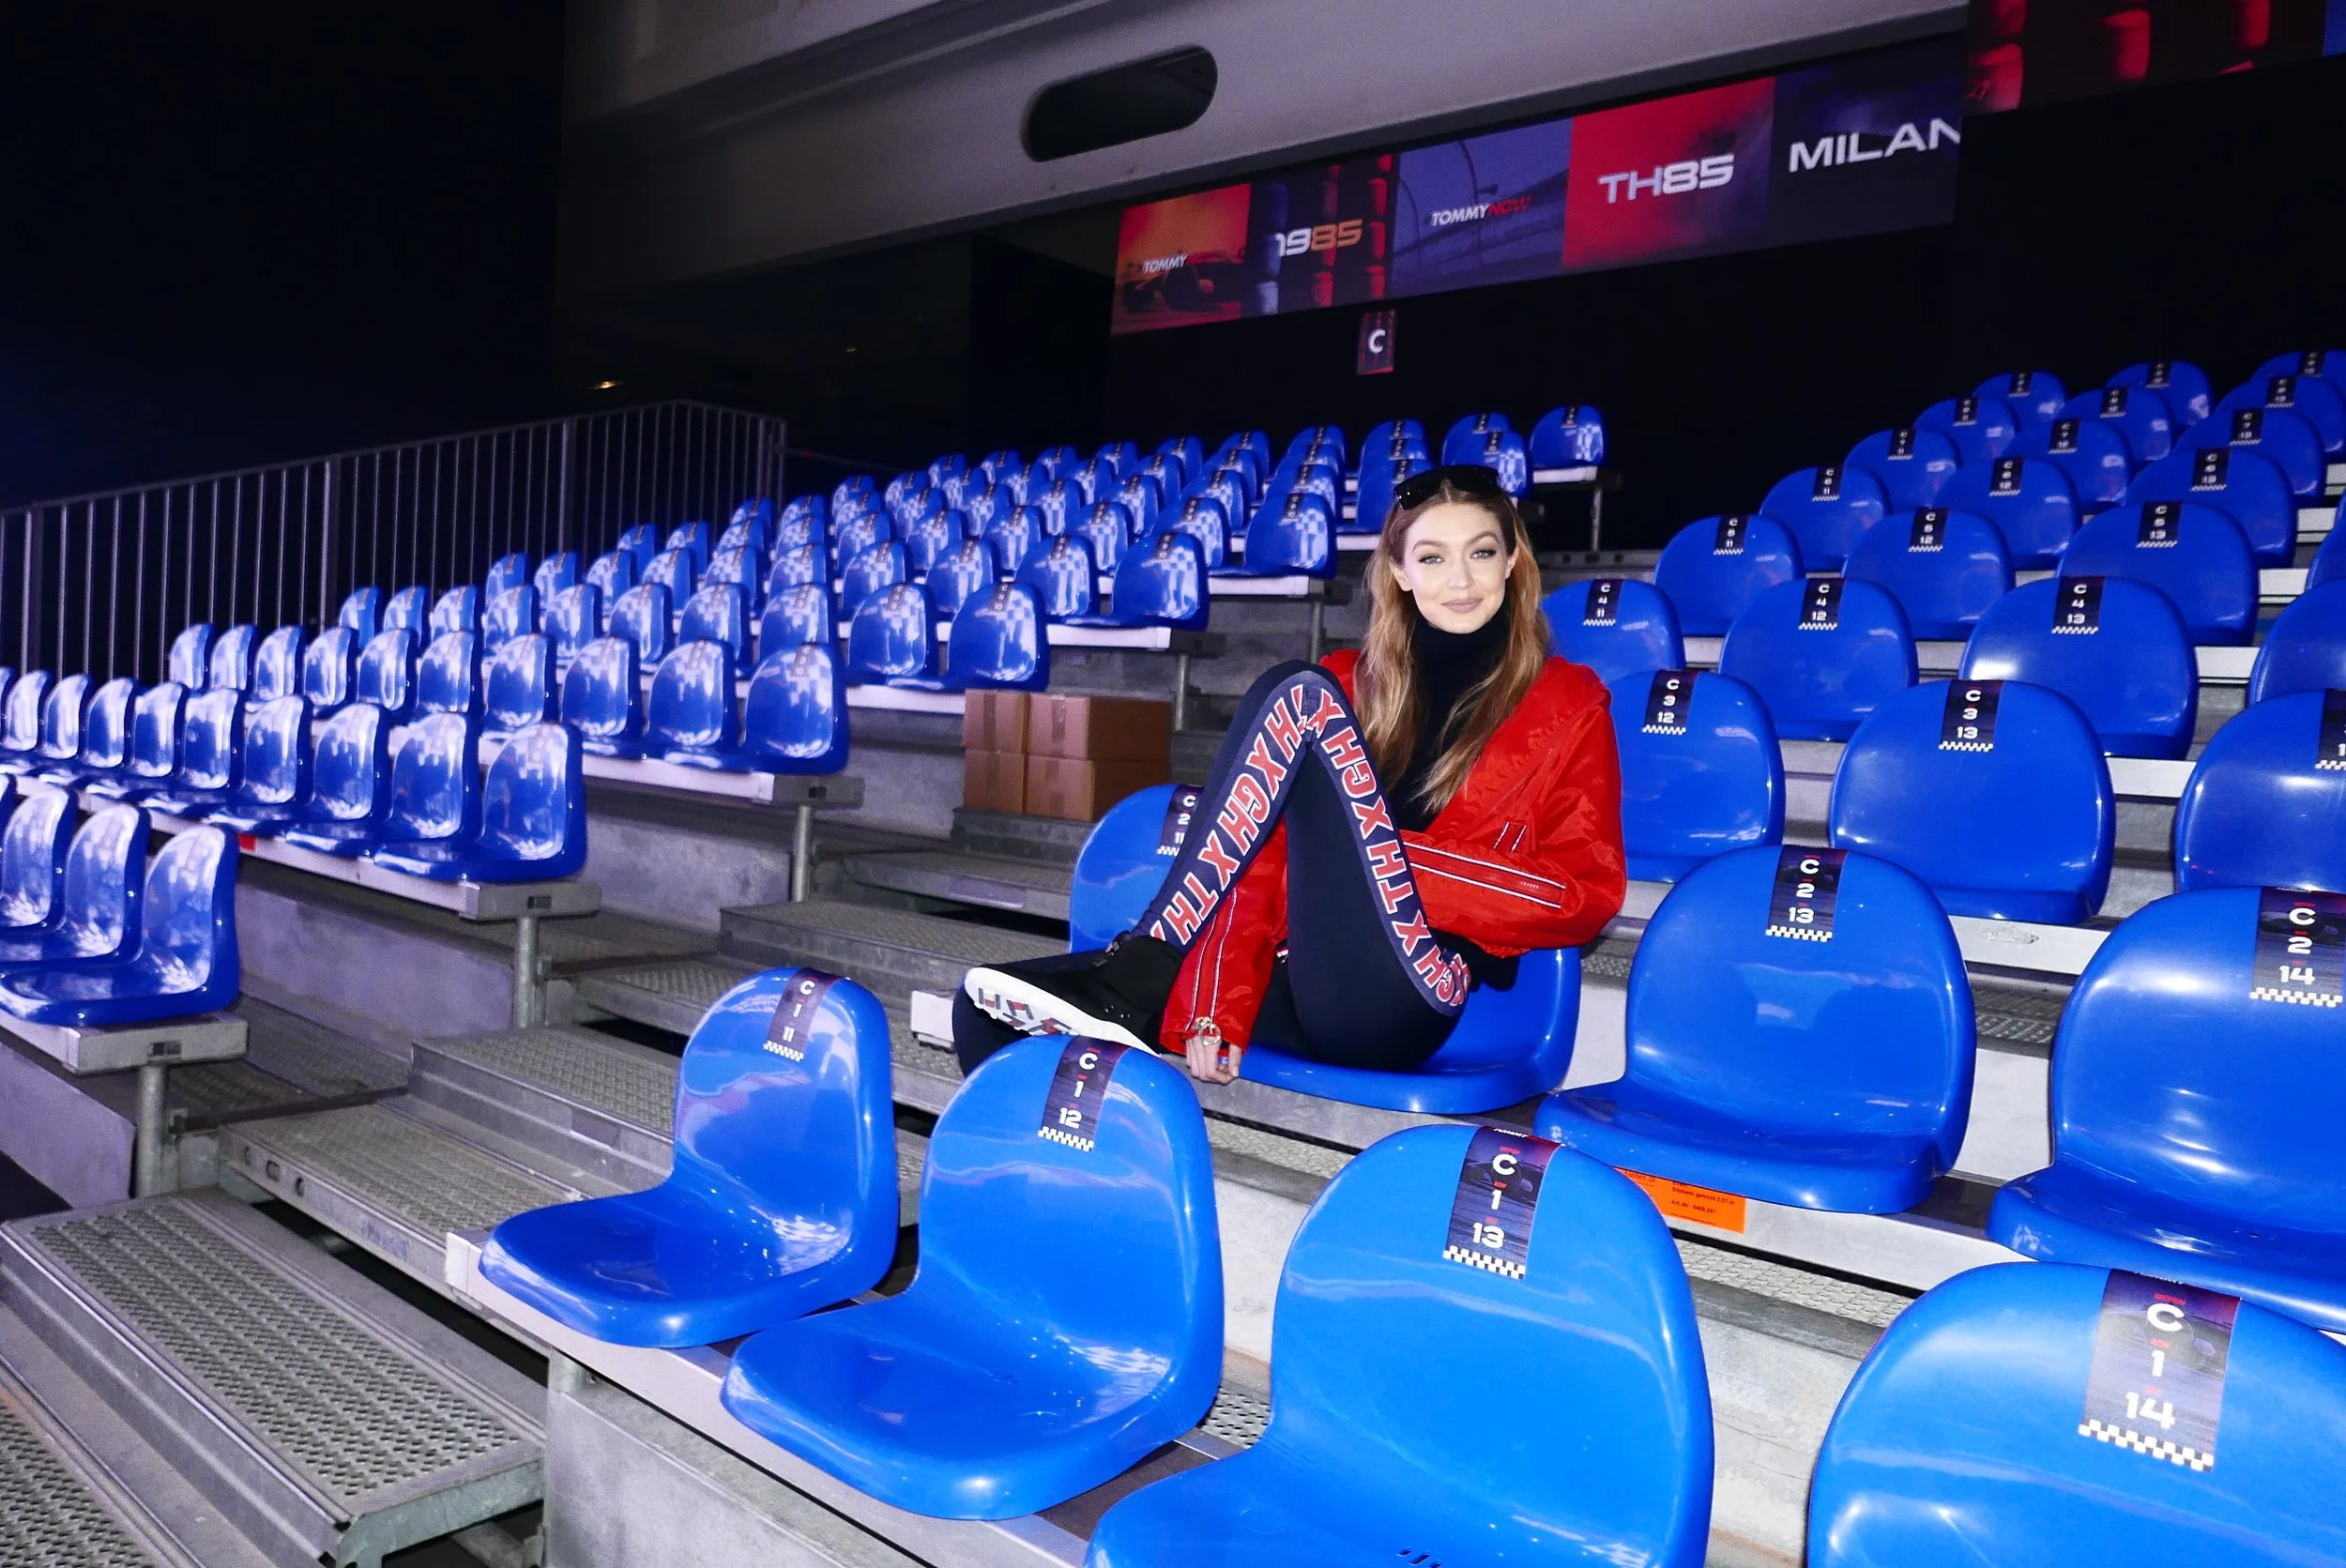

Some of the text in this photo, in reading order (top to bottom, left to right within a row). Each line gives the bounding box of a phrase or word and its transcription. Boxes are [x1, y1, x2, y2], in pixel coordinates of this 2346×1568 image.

[1599, 154, 1734, 204] TH85
[1275, 219, 1363, 257] 1985
[1368, 329, 1386, 354] C
[2206, 453, 2217, 462] C
[2003, 461, 2013, 469] C
[1999, 480, 2012, 489] 12
[2155, 505, 2167, 514] C
[1729, 518, 1738, 526] C
[1926, 513, 1936, 522] C
[2150, 529, 2166, 540] 13
[1601, 584, 1611, 592] C
[1819, 584, 1830, 593] C
[2074, 584, 2087, 594] C
[1598, 596, 1607, 604] 4
[1817, 597, 1827, 606] 4
[2072, 600, 2085, 608] 4
[1596, 608, 1605, 617] 11
[1812, 611, 1827, 620] 12
[2067, 614, 2085, 624] 13
[1667, 679, 1680, 690] C
[1663, 695, 1676, 706] 3
[1965, 690, 1981, 701] C
[1657, 712, 1674, 723] 12
[1963, 708, 1977, 720] 3
[1958, 726, 1978, 738] 13
[1183, 795, 1196, 807] C
[1178, 813, 1190, 825] 2
[1175, 831, 1184, 845] 11
[1800, 860, 1820, 875] C
[1796, 883, 1815, 898] 2
[1789, 907, 1815, 923] 13
[2290, 907, 2316, 925] C
[2288, 936, 2312, 954] 2
[2278, 966, 2315, 985] 14
[800, 981, 815, 995] C
[783, 1026, 795, 1042] 11
[1079, 1053, 1098, 1070] C
[1074, 1081, 1084, 1098] 1
[1059, 1107, 1083, 1129] 12
[1493, 1153, 1517, 1175] C
[1491, 1190, 1502, 1210] 1
[1472, 1222, 1505, 1249] 13
[2147, 1302, 2185, 1332] C
[2152, 1349, 2165, 1378] 1
[2125, 1391, 2175, 1430] 14
